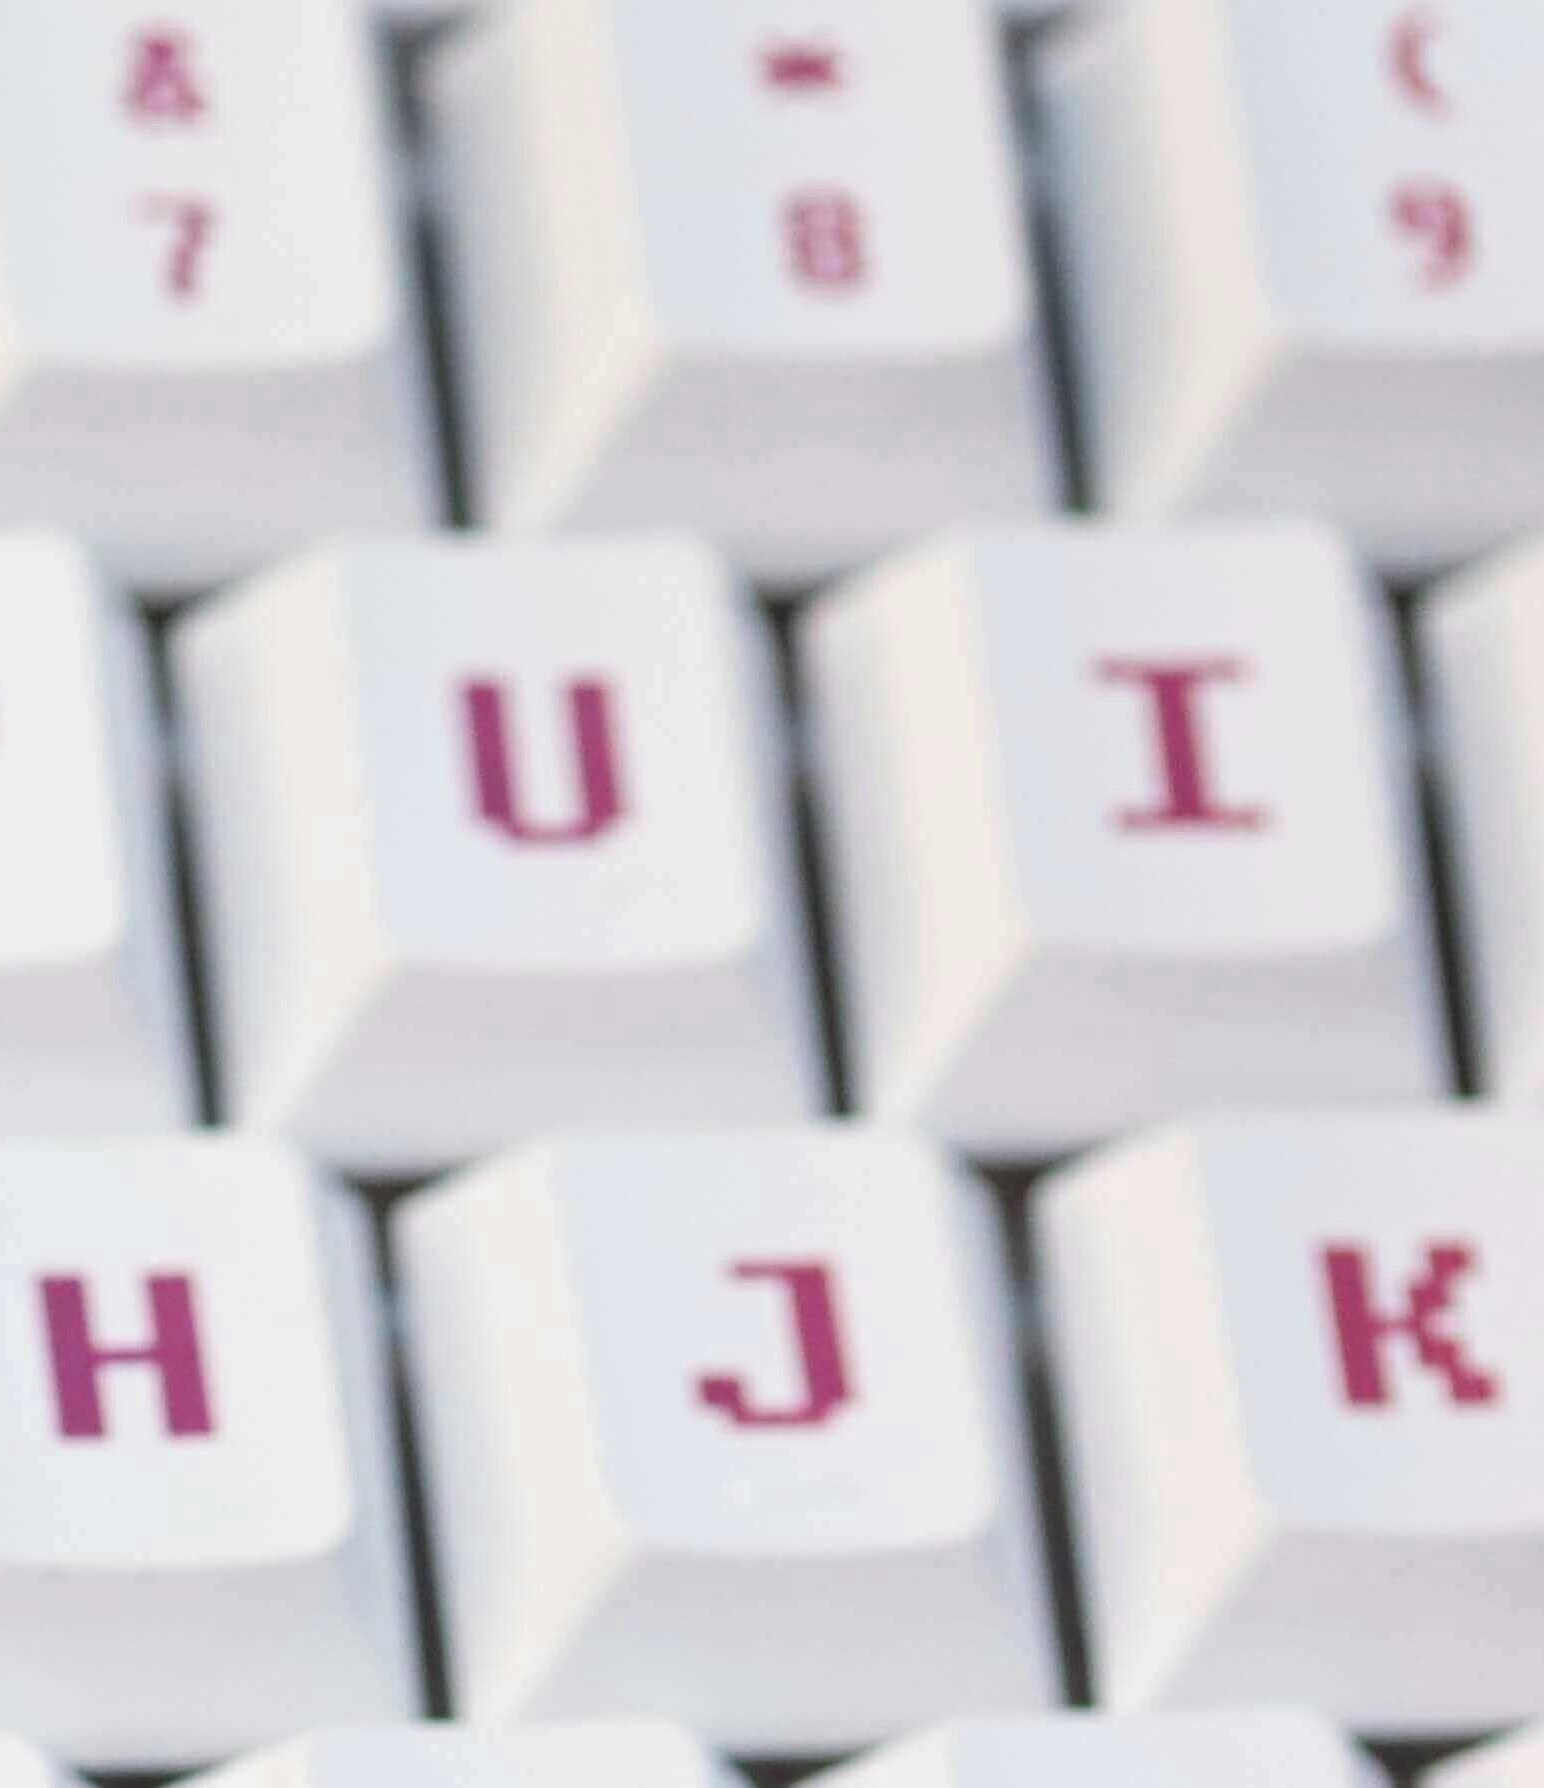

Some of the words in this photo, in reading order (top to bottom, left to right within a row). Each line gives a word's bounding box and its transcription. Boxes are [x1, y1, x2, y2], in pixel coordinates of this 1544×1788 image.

[121, 34, 209, 124] &
[137, 194, 219, 300] 7
[779, 193, 869, 298] 8
[1389, 184, 1475, 292] 9
[457, 676, 629, 844] U
[1102, 662, 1265, 832] I
[39, 1272, 213, 1438] H
[691, 1257, 854, 1430] J
[1319, 1242, 1498, 1407] K
